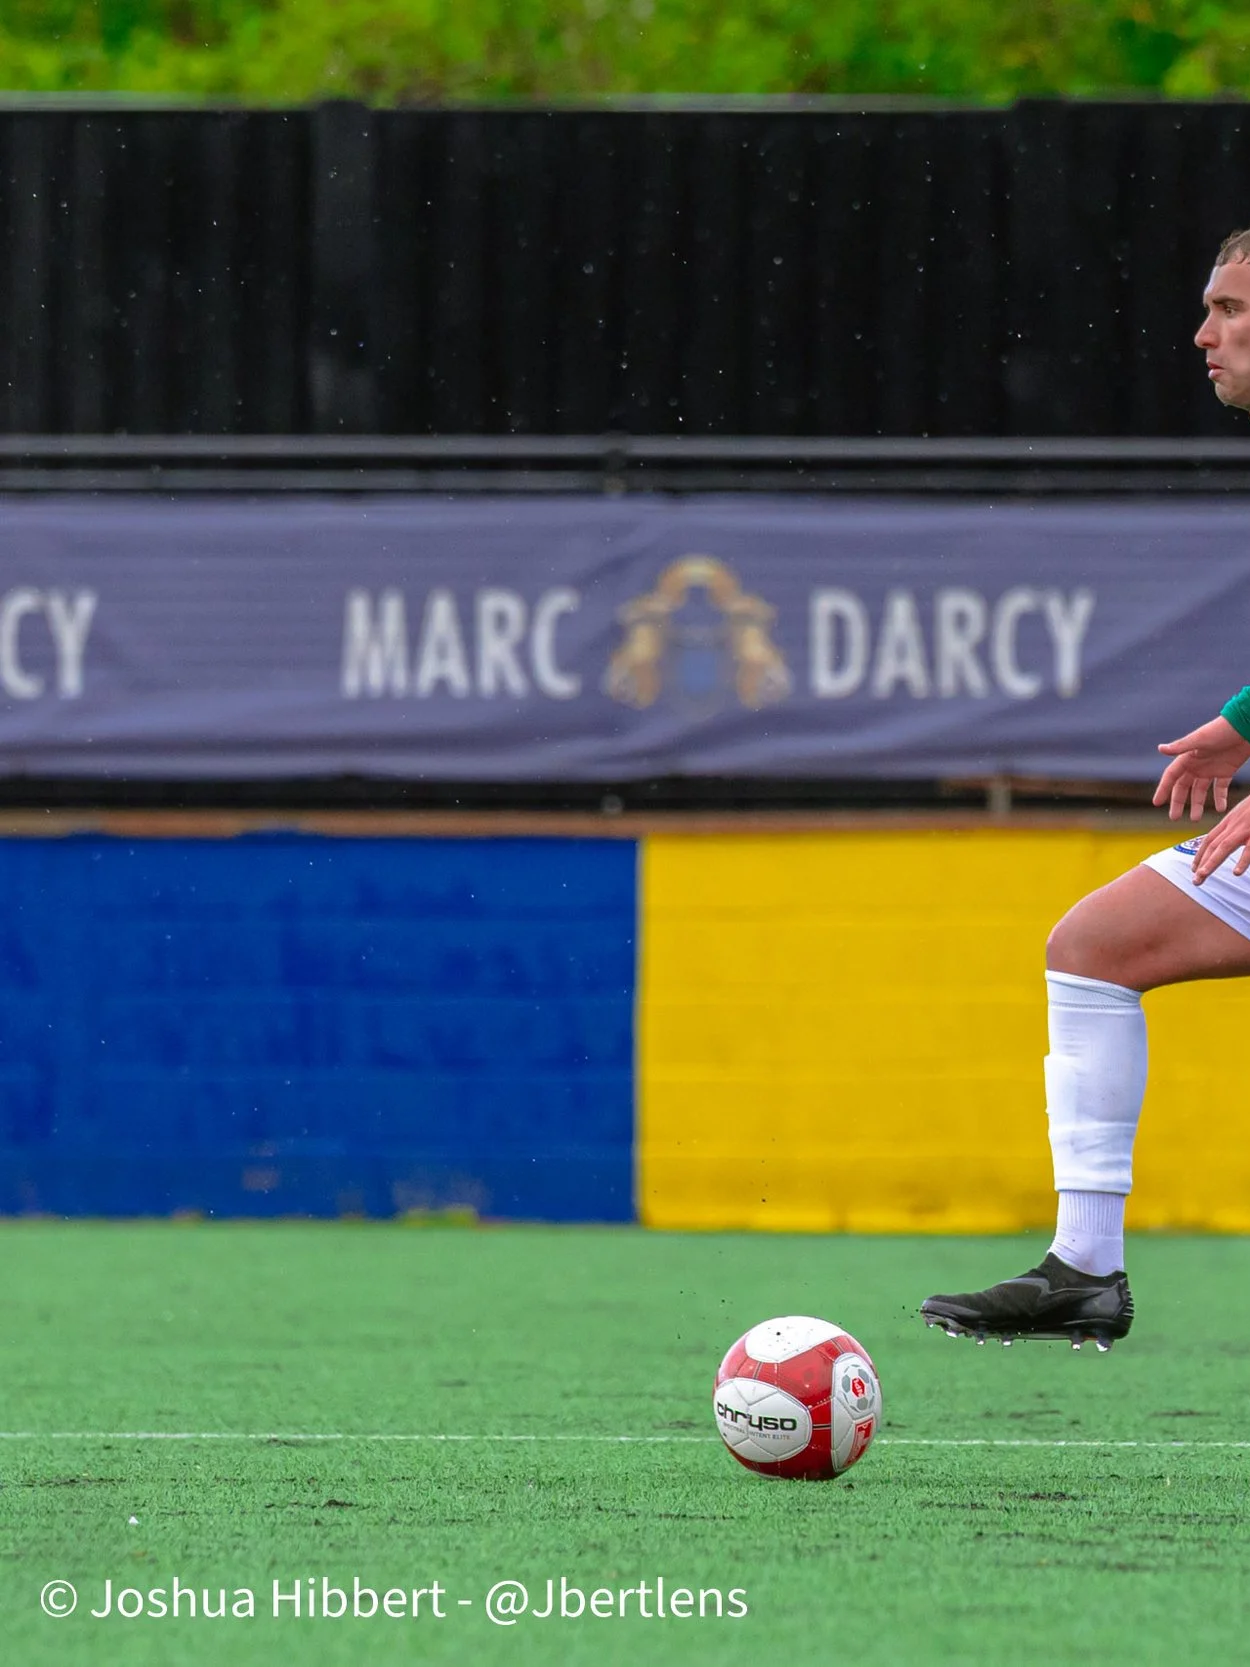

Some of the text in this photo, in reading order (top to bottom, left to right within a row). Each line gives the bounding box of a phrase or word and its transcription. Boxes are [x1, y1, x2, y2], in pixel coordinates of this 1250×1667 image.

[0, 590, 97, 699] CY
[340, 590, 1097, 699] MARC DARCY
[717, 1401, 797, 1431] chryso
